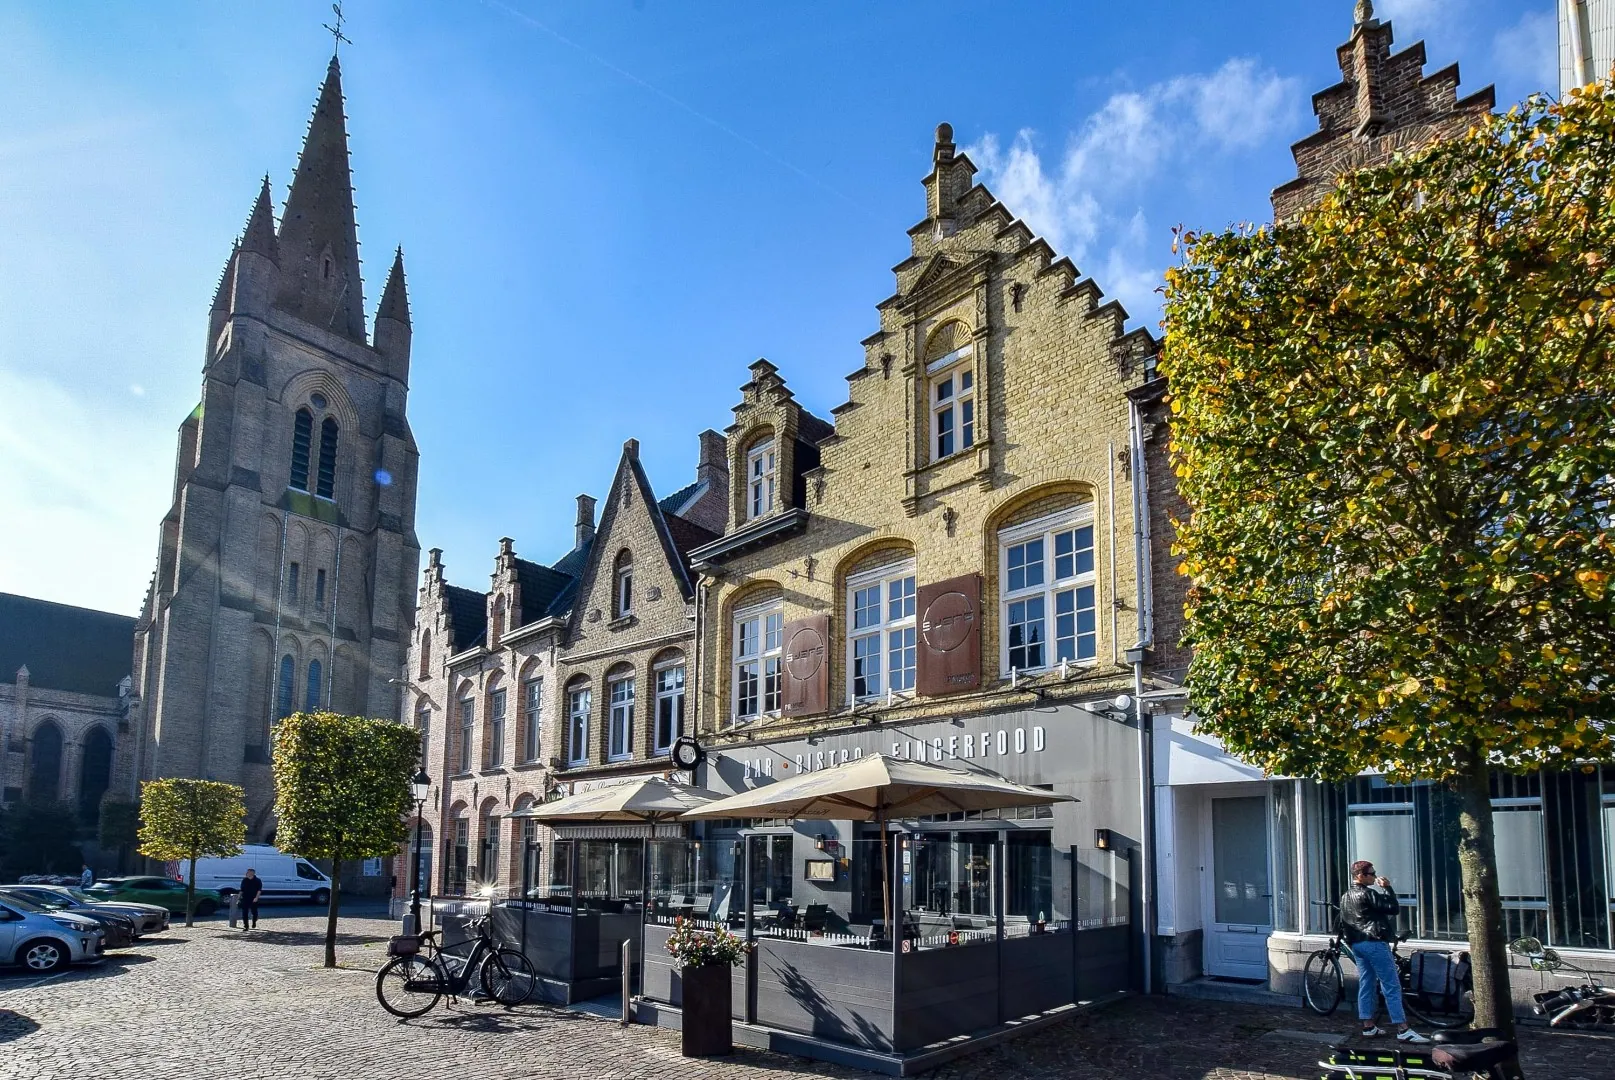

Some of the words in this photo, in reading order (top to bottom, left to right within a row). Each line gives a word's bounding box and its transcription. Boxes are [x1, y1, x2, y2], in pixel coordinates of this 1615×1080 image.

[744, 757, 772, 779] BAR
[892, 726, 1045, 762] FINGERFOOD
[769, 926, 782, 936] BAR
[786, 928, 811, 940] BISTRO
[823, 931, 870, 946] FINGERFOOD
[913, 937, 925, 947] BAR
[928, 934, 950, 945] BISTRO
